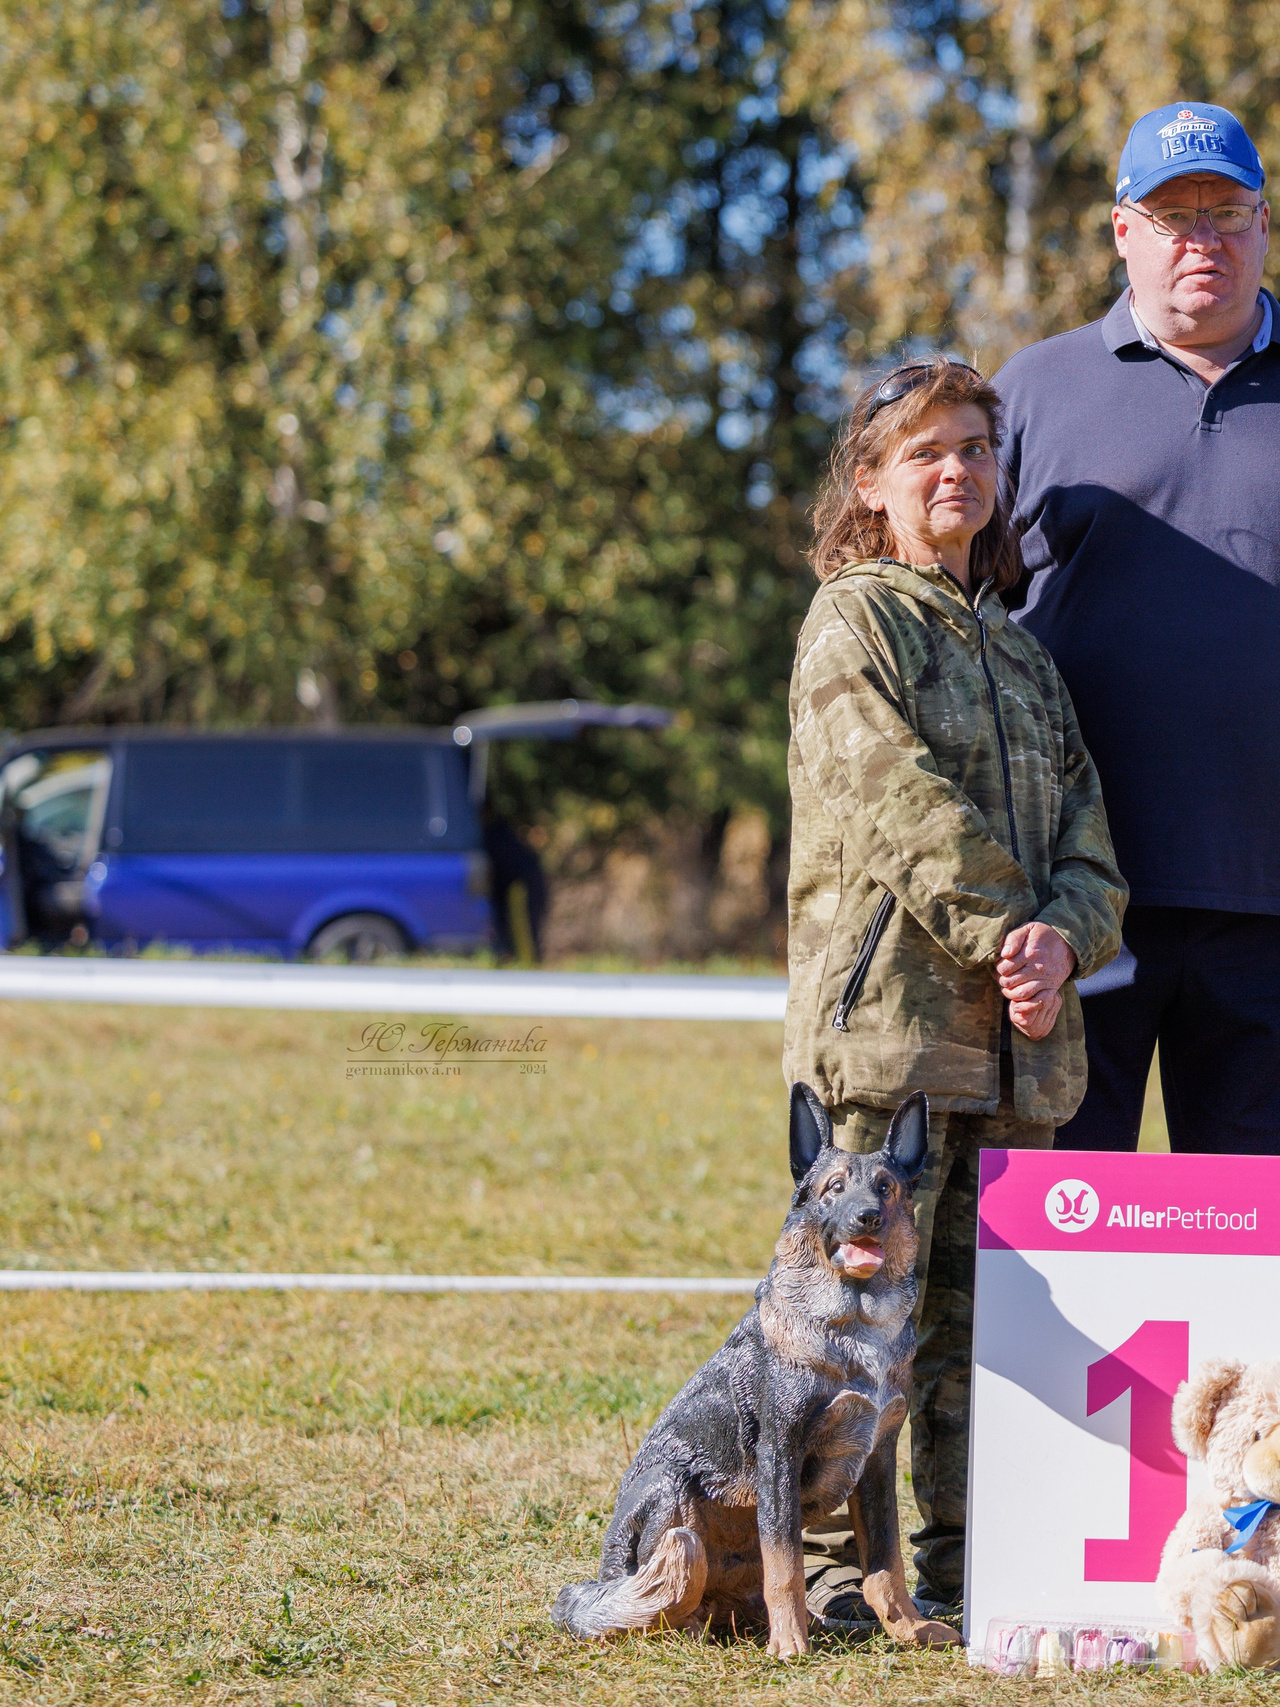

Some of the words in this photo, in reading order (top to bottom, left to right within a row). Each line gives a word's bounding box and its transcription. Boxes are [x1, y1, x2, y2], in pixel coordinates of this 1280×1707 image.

[1162, 133, 1222, 160] 1946
[1106, 1204, 1258, 1231] AllerPetfood
[1083, 1320, 1190, 1583] 1
